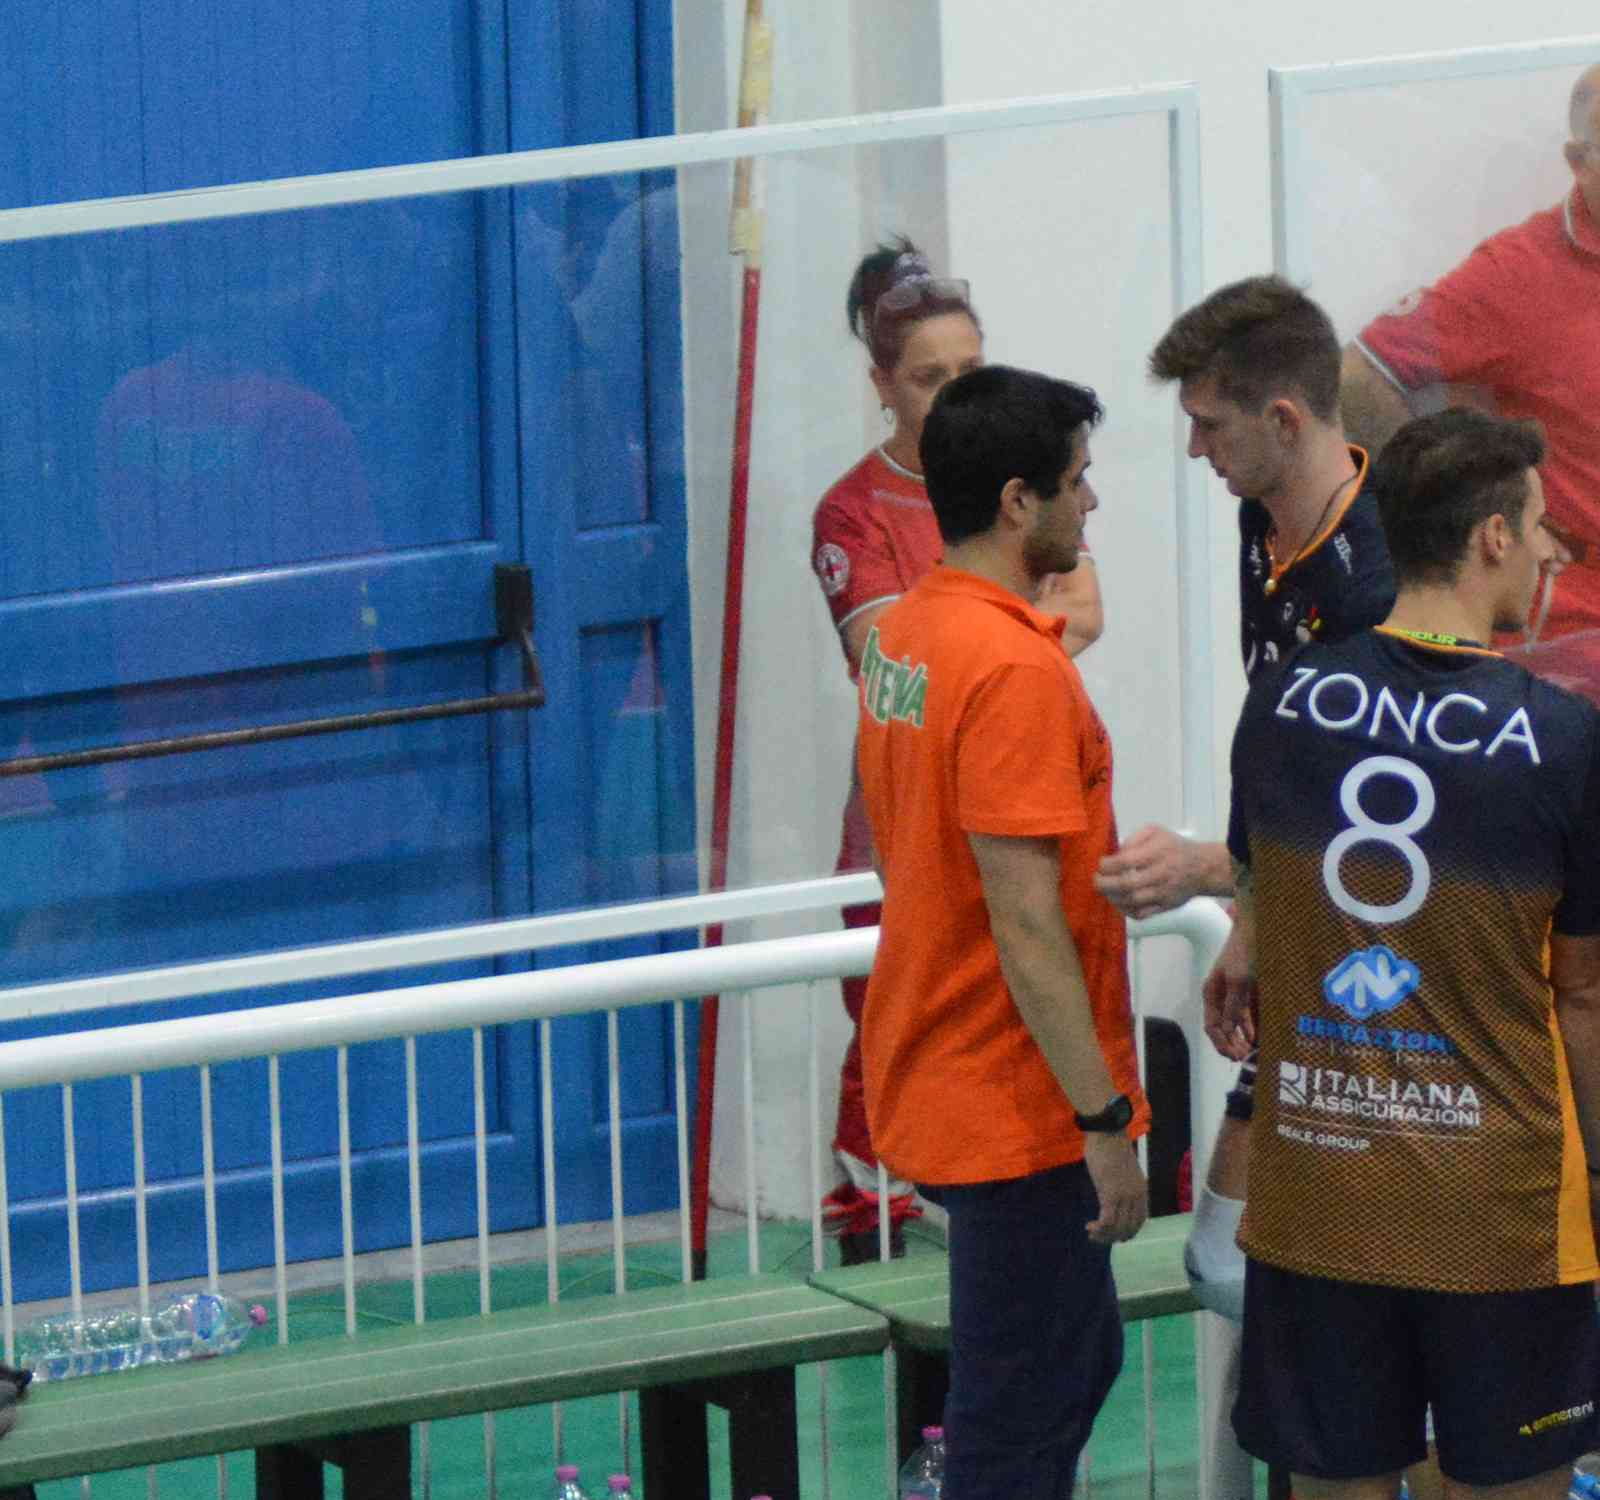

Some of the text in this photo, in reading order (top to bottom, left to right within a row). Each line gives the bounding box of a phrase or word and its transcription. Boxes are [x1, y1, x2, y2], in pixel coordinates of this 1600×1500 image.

[1276, 667, 1541, 764] ZONCA
[1323, 755, 1436, 923] 8
[1312, 1067, 1480, 1108] ITALIANA
[1310, 1093, 1481, 1127] ASSICURAZIONI
[1315, 1132, 1371, 1151] GROUP
